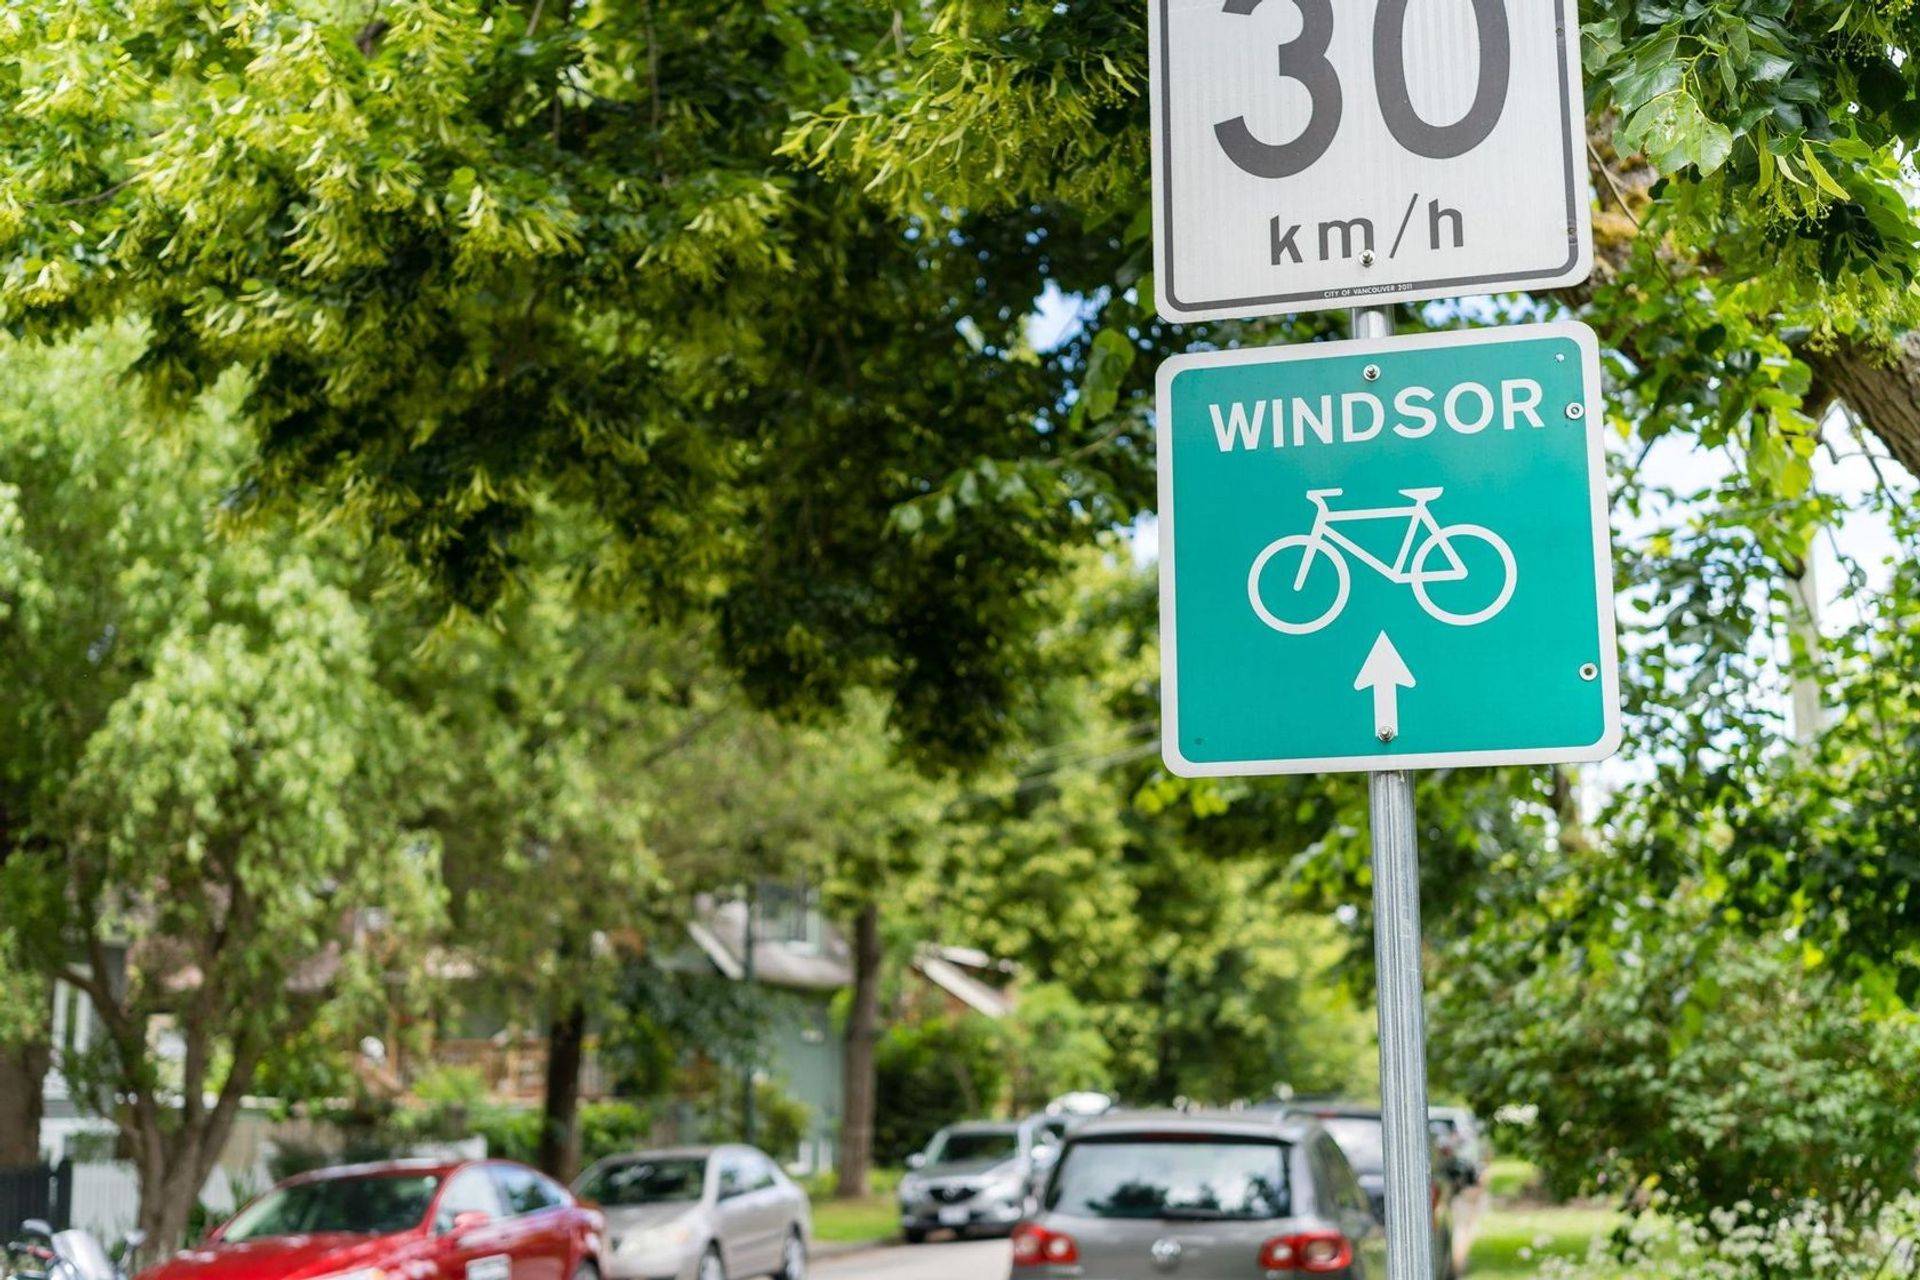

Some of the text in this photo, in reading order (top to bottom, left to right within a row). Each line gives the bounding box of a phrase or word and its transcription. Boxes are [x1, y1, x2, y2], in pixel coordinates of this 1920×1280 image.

[1214, 0, 1510, 179] 30
[1270, 193, 1464, 265] km/h
[1353, 285, 1395, 295] VANCOUVER
[1209, 378, 1545, 452] WINDSOR
